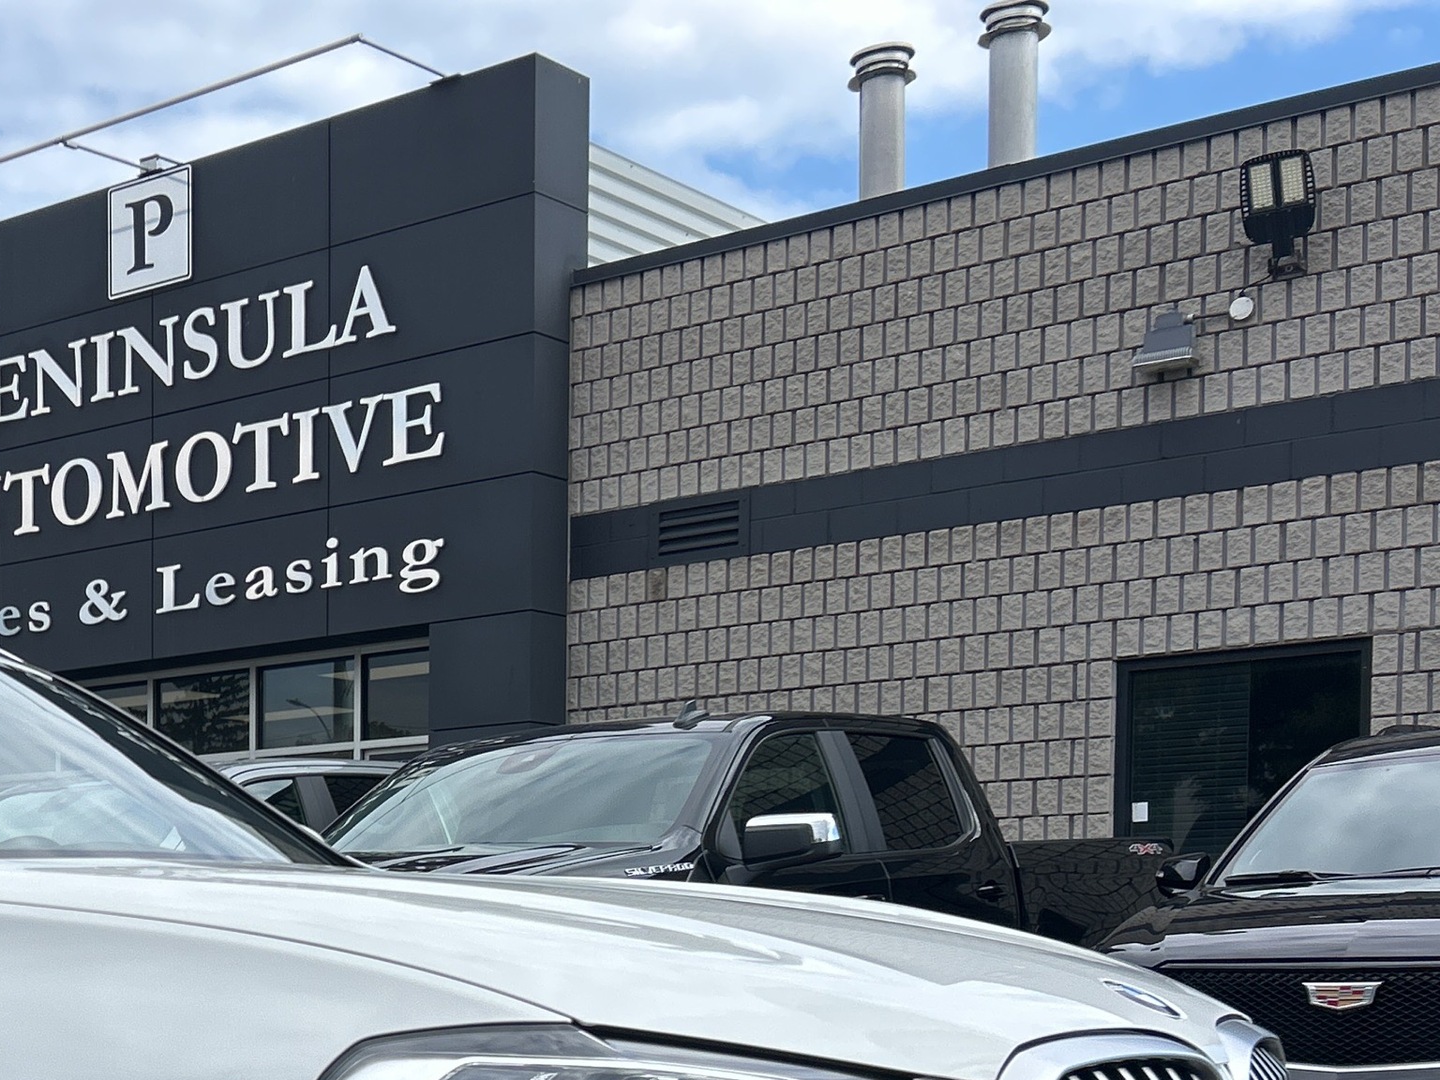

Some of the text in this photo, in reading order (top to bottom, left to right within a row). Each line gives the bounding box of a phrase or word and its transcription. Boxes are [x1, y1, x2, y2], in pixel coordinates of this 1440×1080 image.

[125, 192, 174, 276] P
[78, 578, 128, 626] &
[155, 537, 444, 614] Leasing
